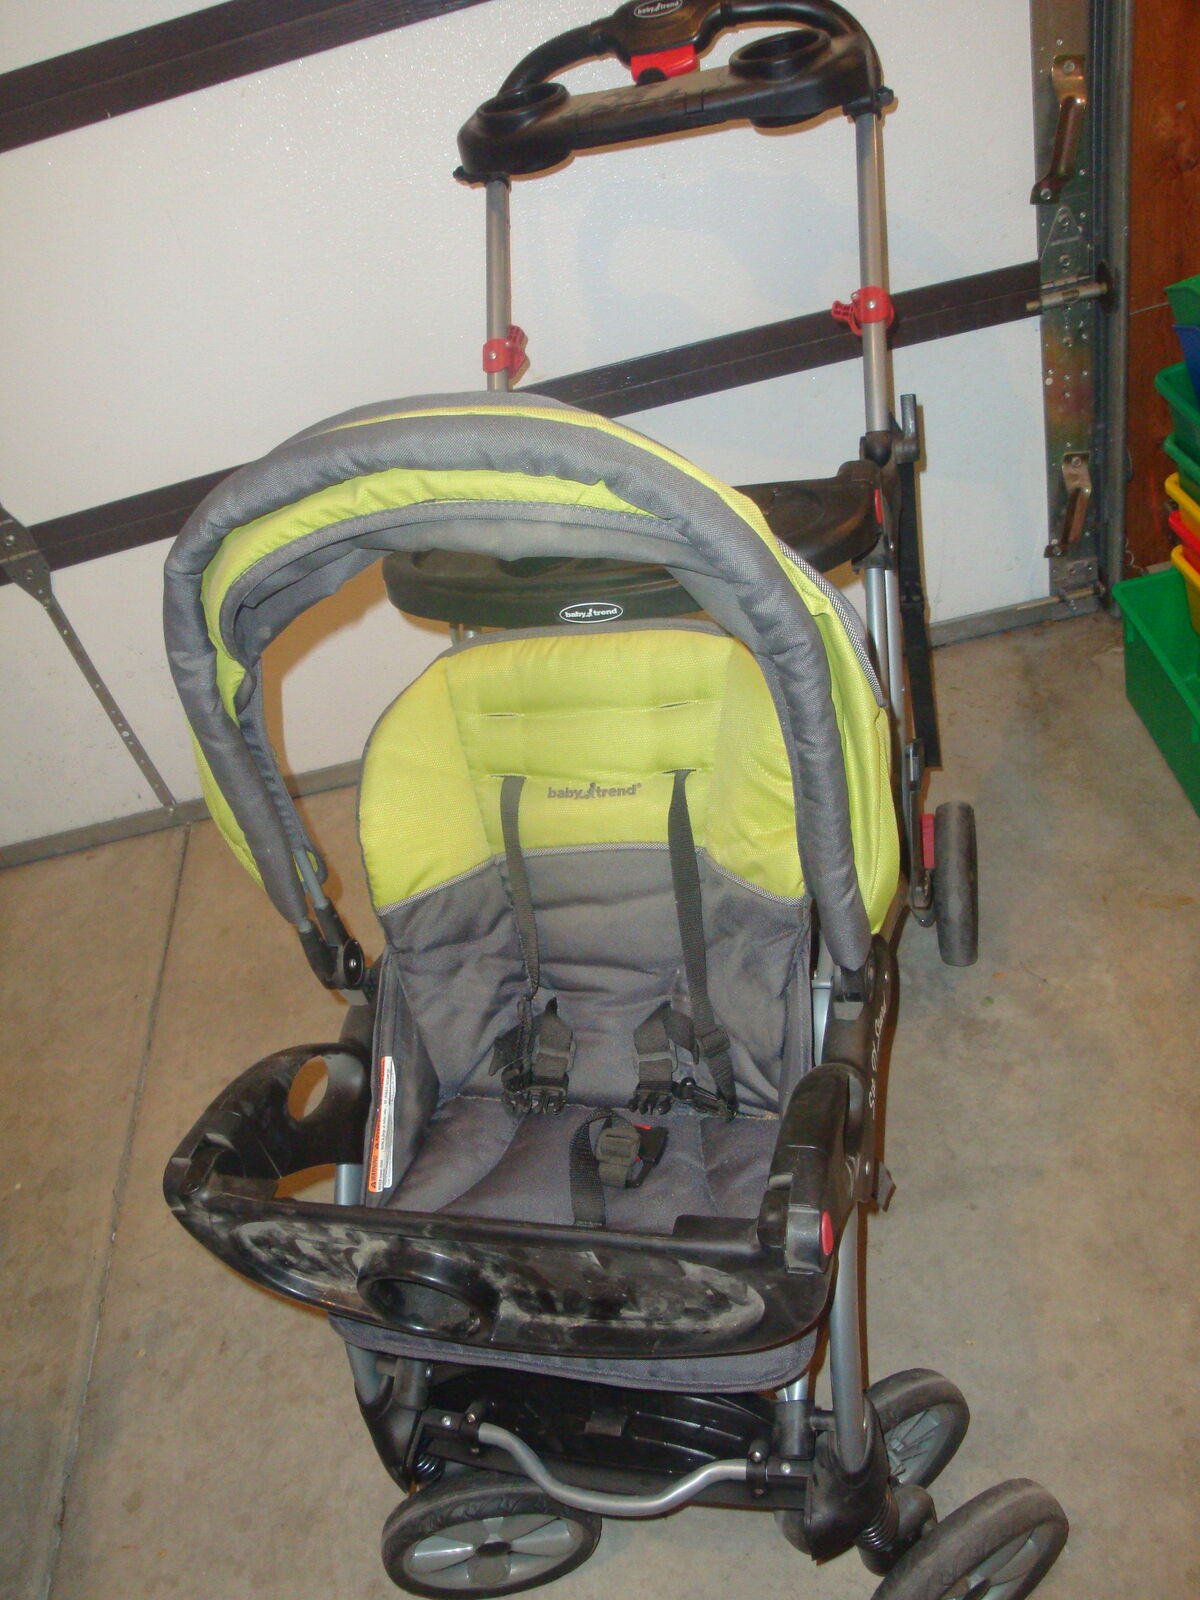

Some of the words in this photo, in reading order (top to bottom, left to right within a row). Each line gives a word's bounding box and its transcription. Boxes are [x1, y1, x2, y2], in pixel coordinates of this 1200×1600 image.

[637, 6, 654, 15] baby
[660, 1, 679, 10] trend
[593, 608, 617, 616] trend
[547, 787, 582, 799] baby
